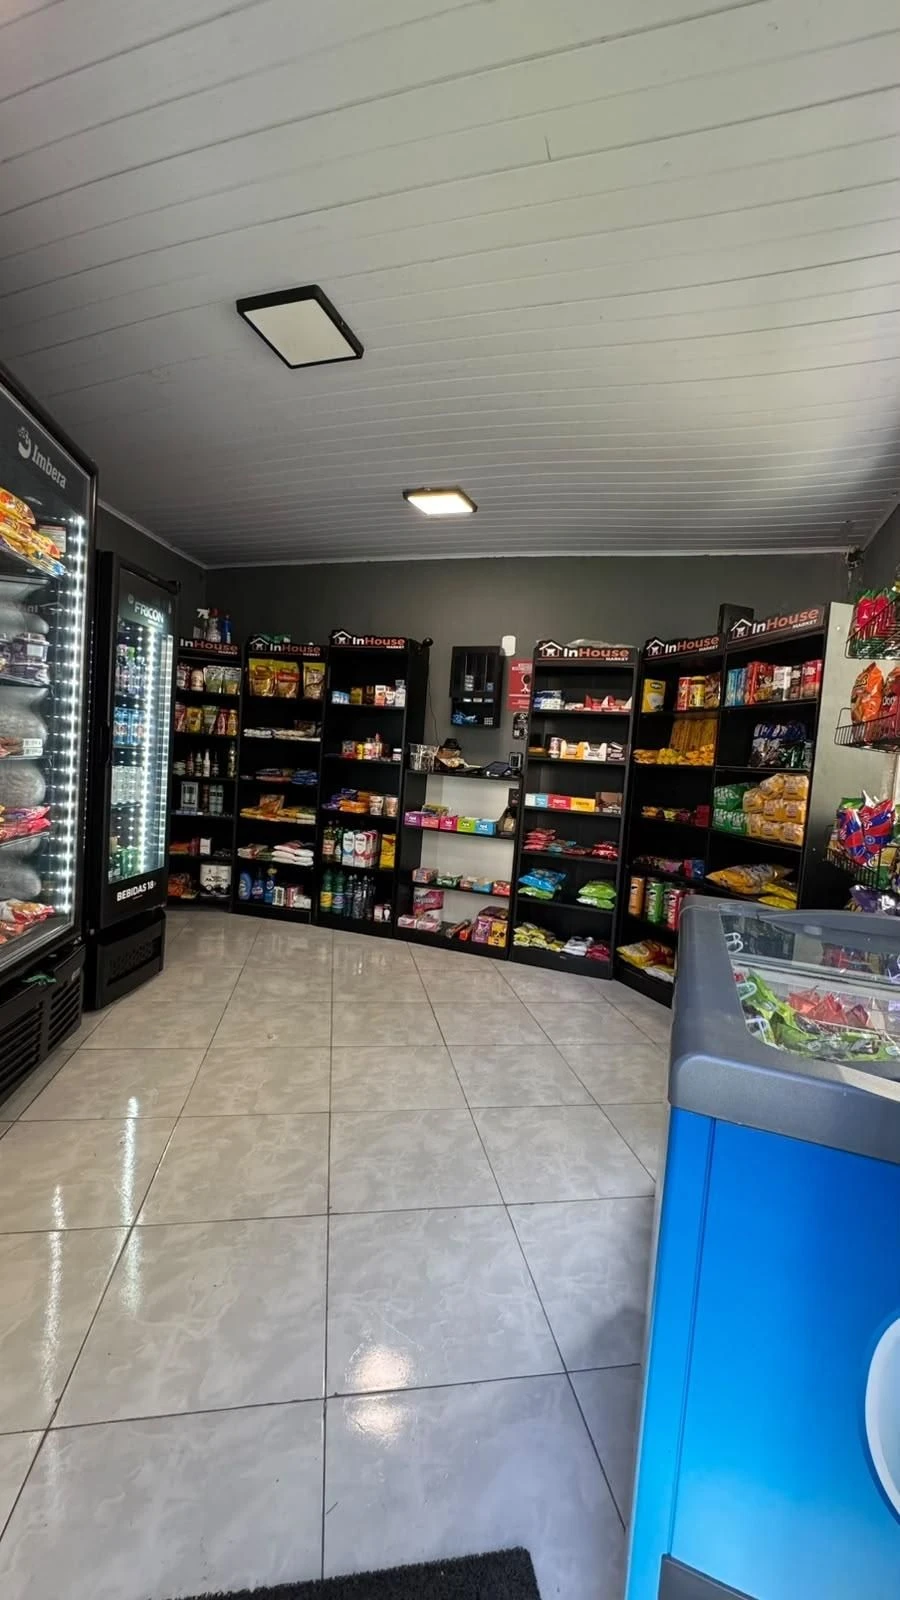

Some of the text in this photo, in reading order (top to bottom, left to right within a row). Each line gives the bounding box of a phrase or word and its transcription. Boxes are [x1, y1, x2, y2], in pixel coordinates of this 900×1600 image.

[31, 444, 67, 489] Imbera
[134, 601, 164, 623] FRICON
[751, 608, 819, 635] InHouse
[180, 638, 238, 651] InHouse
[269, 643, 321, 654] InHouse
[352, 636, 406, 646] InHouse
[665, 636, 720, 654] InHouse
[563, 647, 630, 658] InHouse
[116, 882, 147, 902] BEBIDAS
